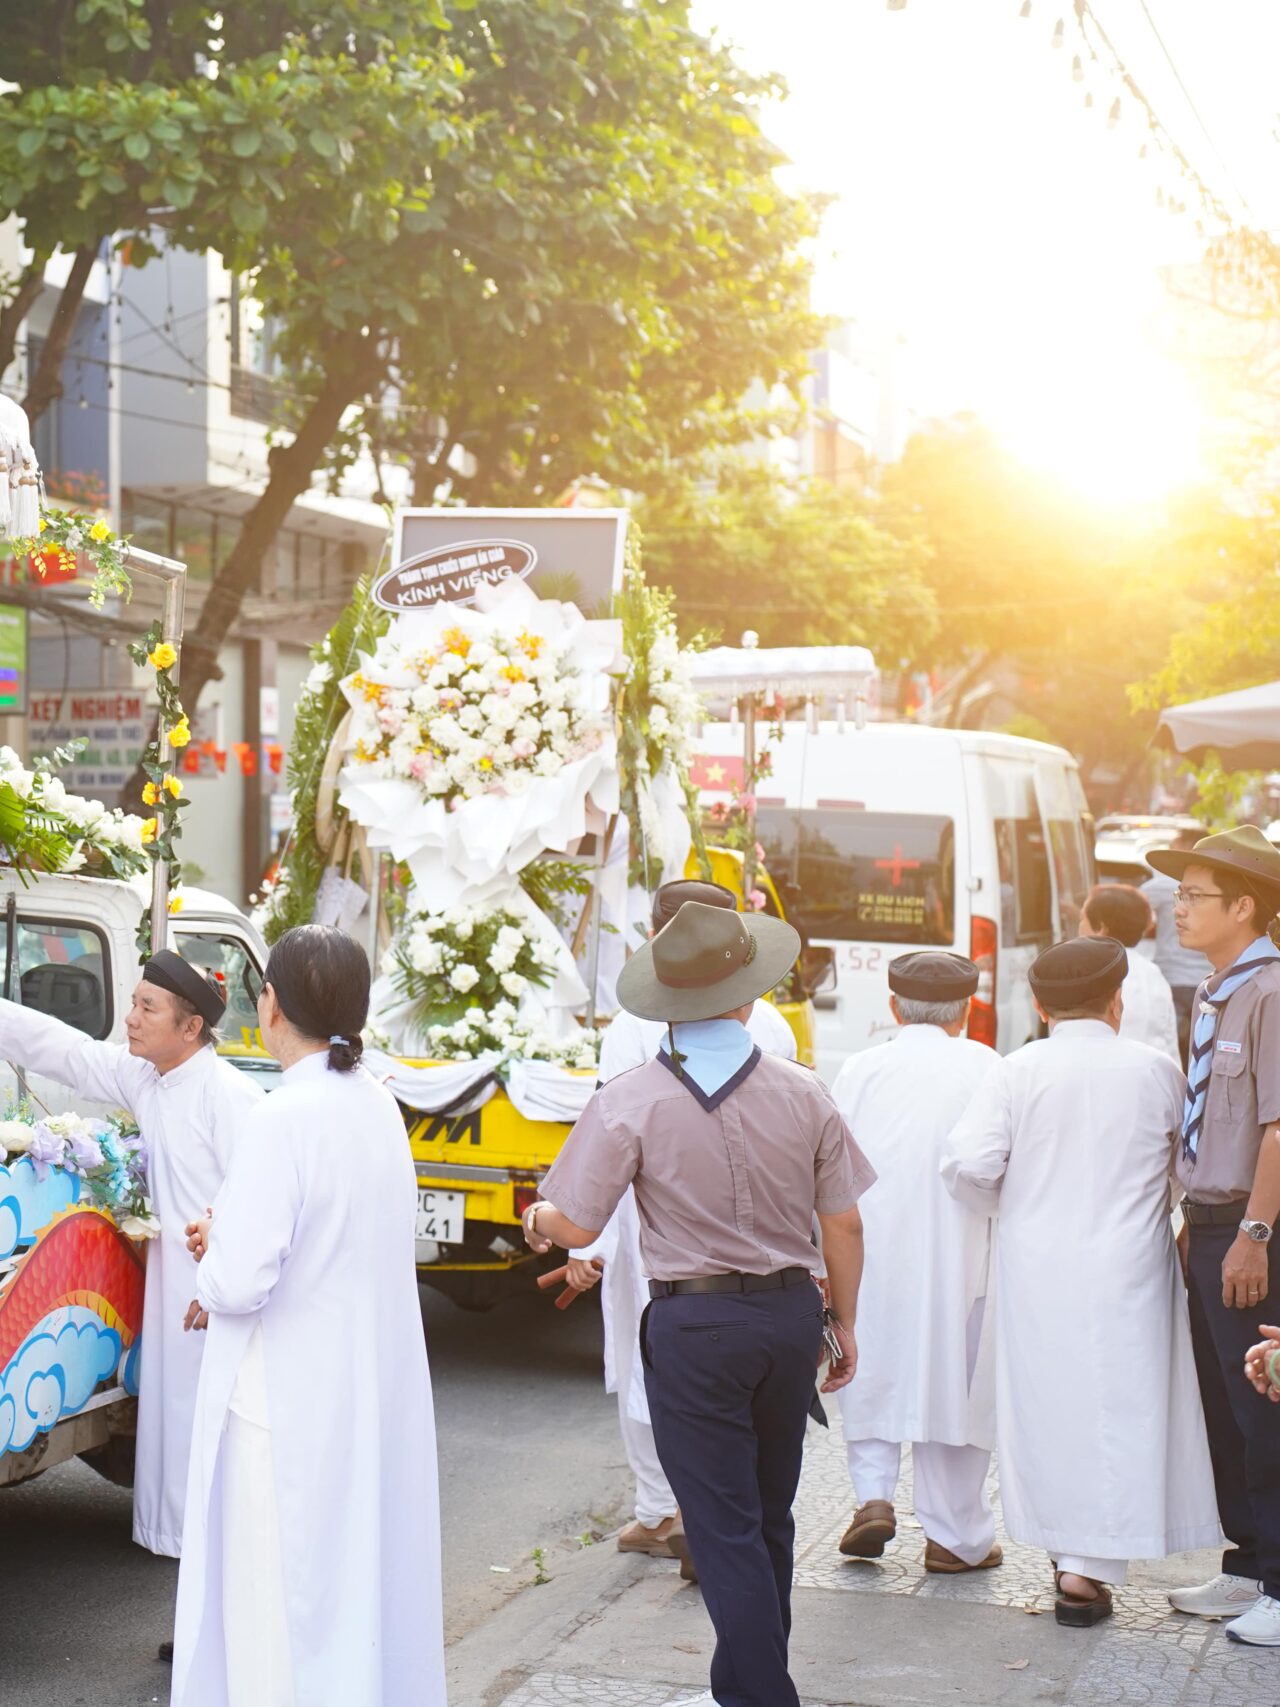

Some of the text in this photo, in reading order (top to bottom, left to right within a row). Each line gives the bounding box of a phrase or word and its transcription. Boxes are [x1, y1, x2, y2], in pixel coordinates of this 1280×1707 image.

[396, 565, 513, 606] KÍNH VIẾNG
[71, 694, 141, 723] NGHIỆM
